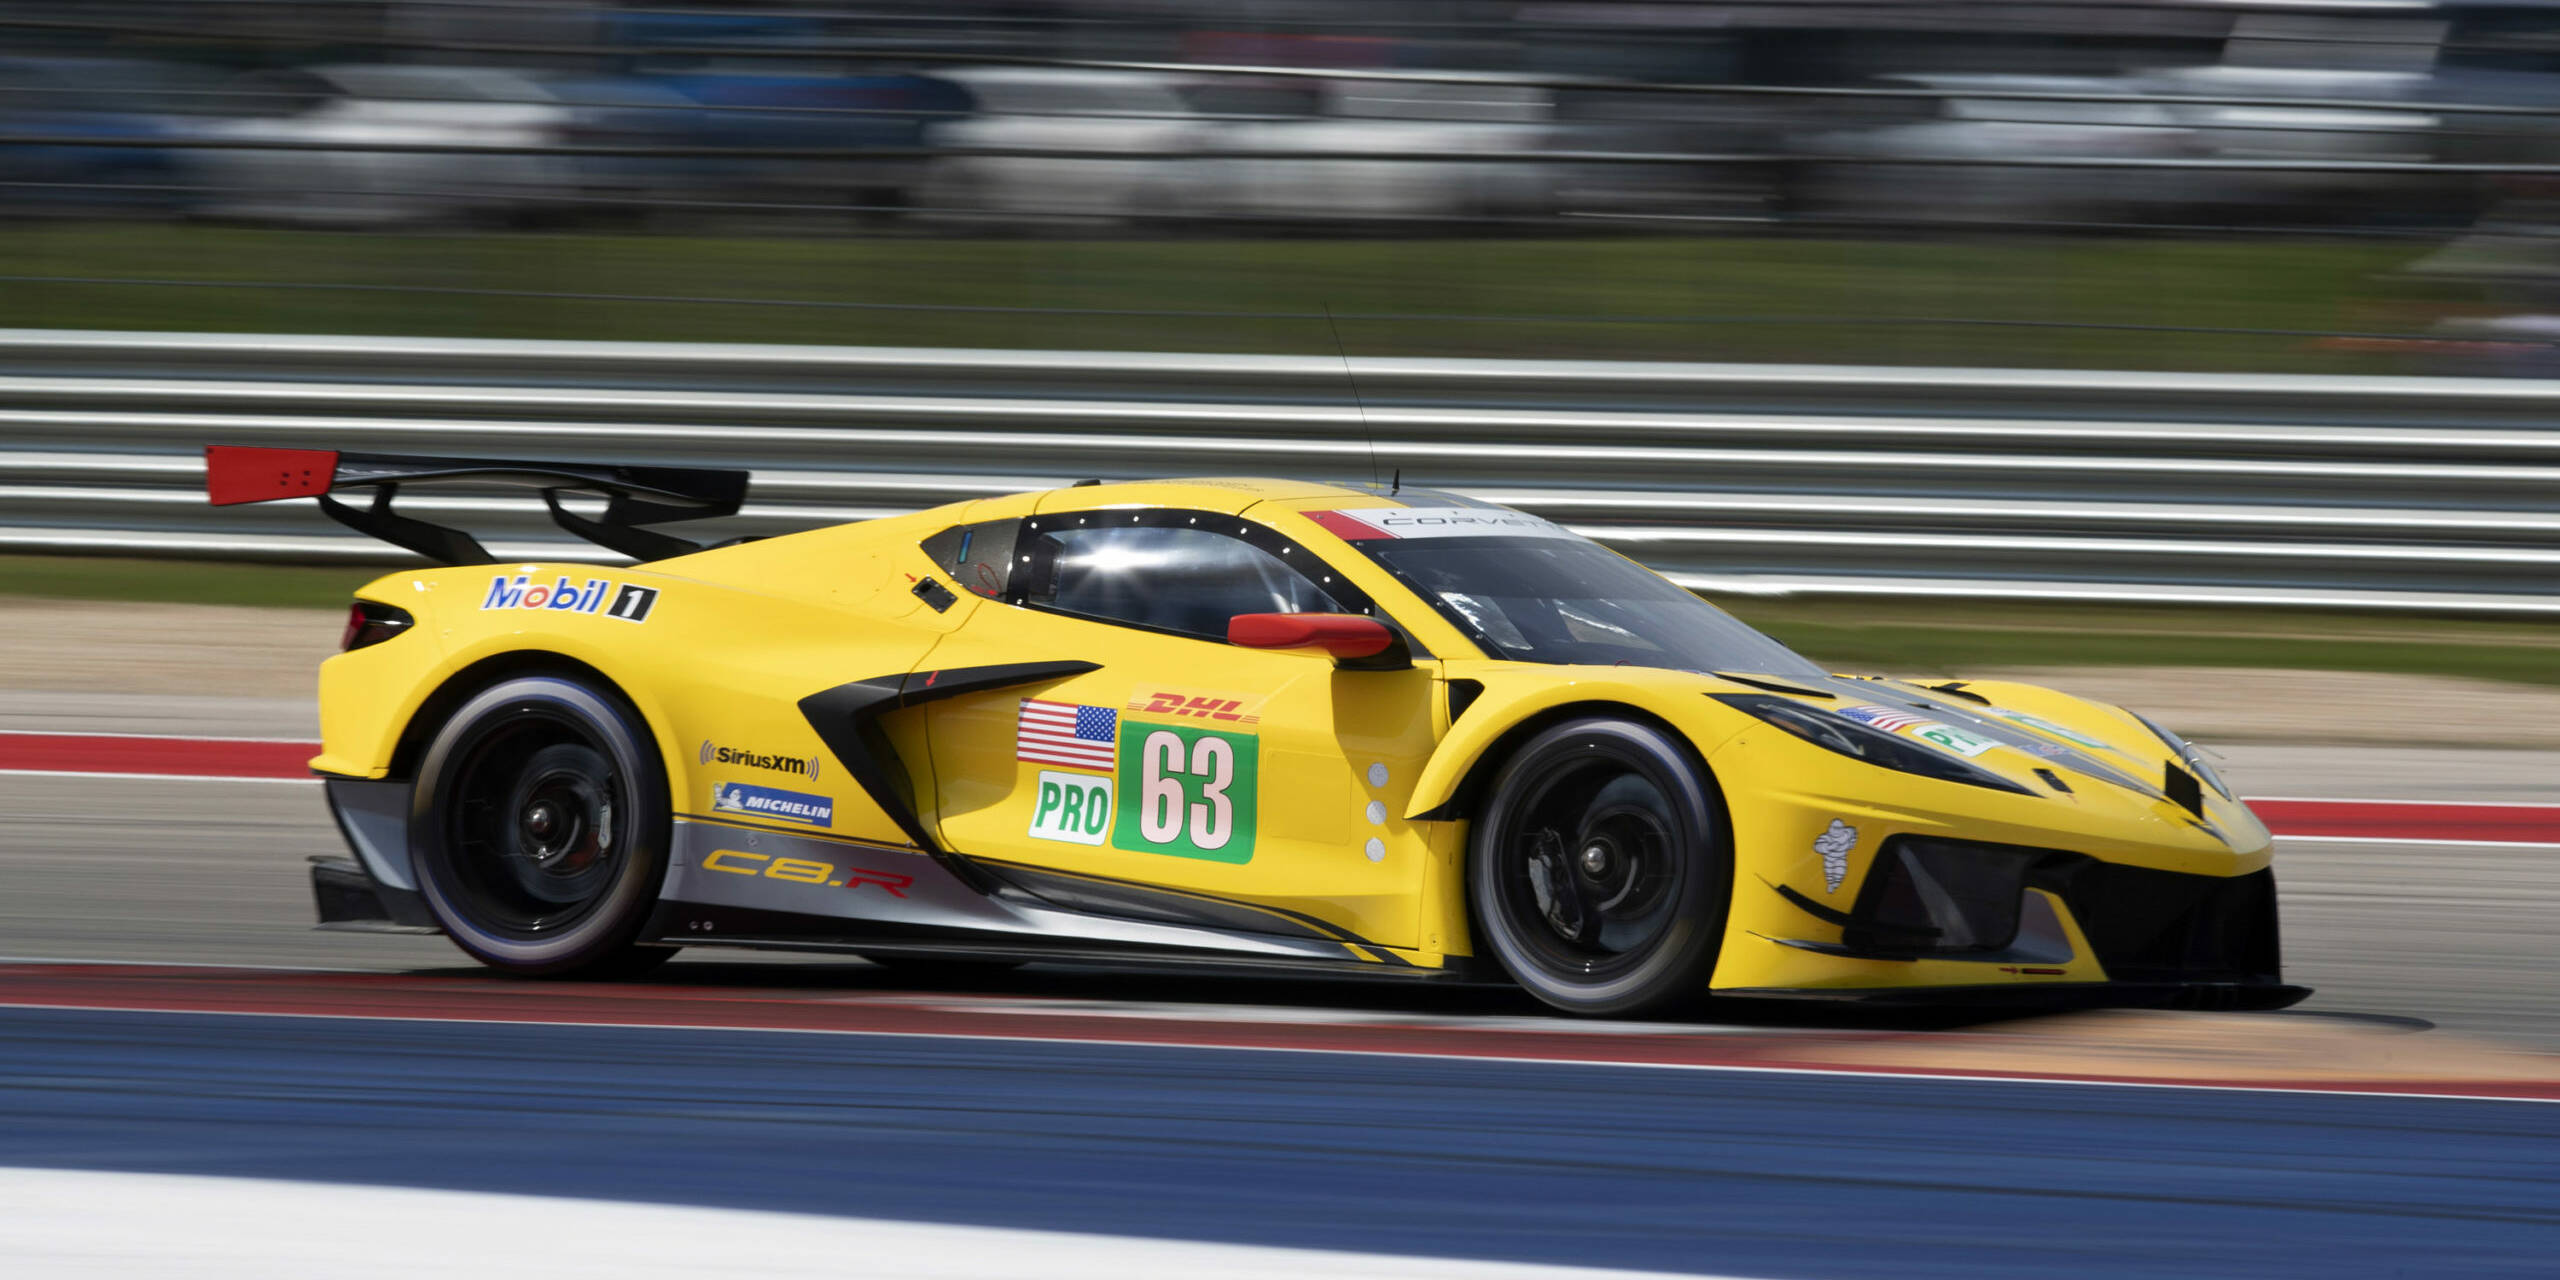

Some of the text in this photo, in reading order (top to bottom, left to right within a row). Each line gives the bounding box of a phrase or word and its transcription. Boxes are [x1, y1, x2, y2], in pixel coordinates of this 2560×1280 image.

[484, 576, 645, 618] Mobil 1
[1143, 692, 1243, 722] DHL
[745, 796, 832, 819] MICHELIN
[1034, 781, 1109, 836] PRO
[1140, 730, 1235, 851] 63
[702, 849, 915, 899] C8.R
